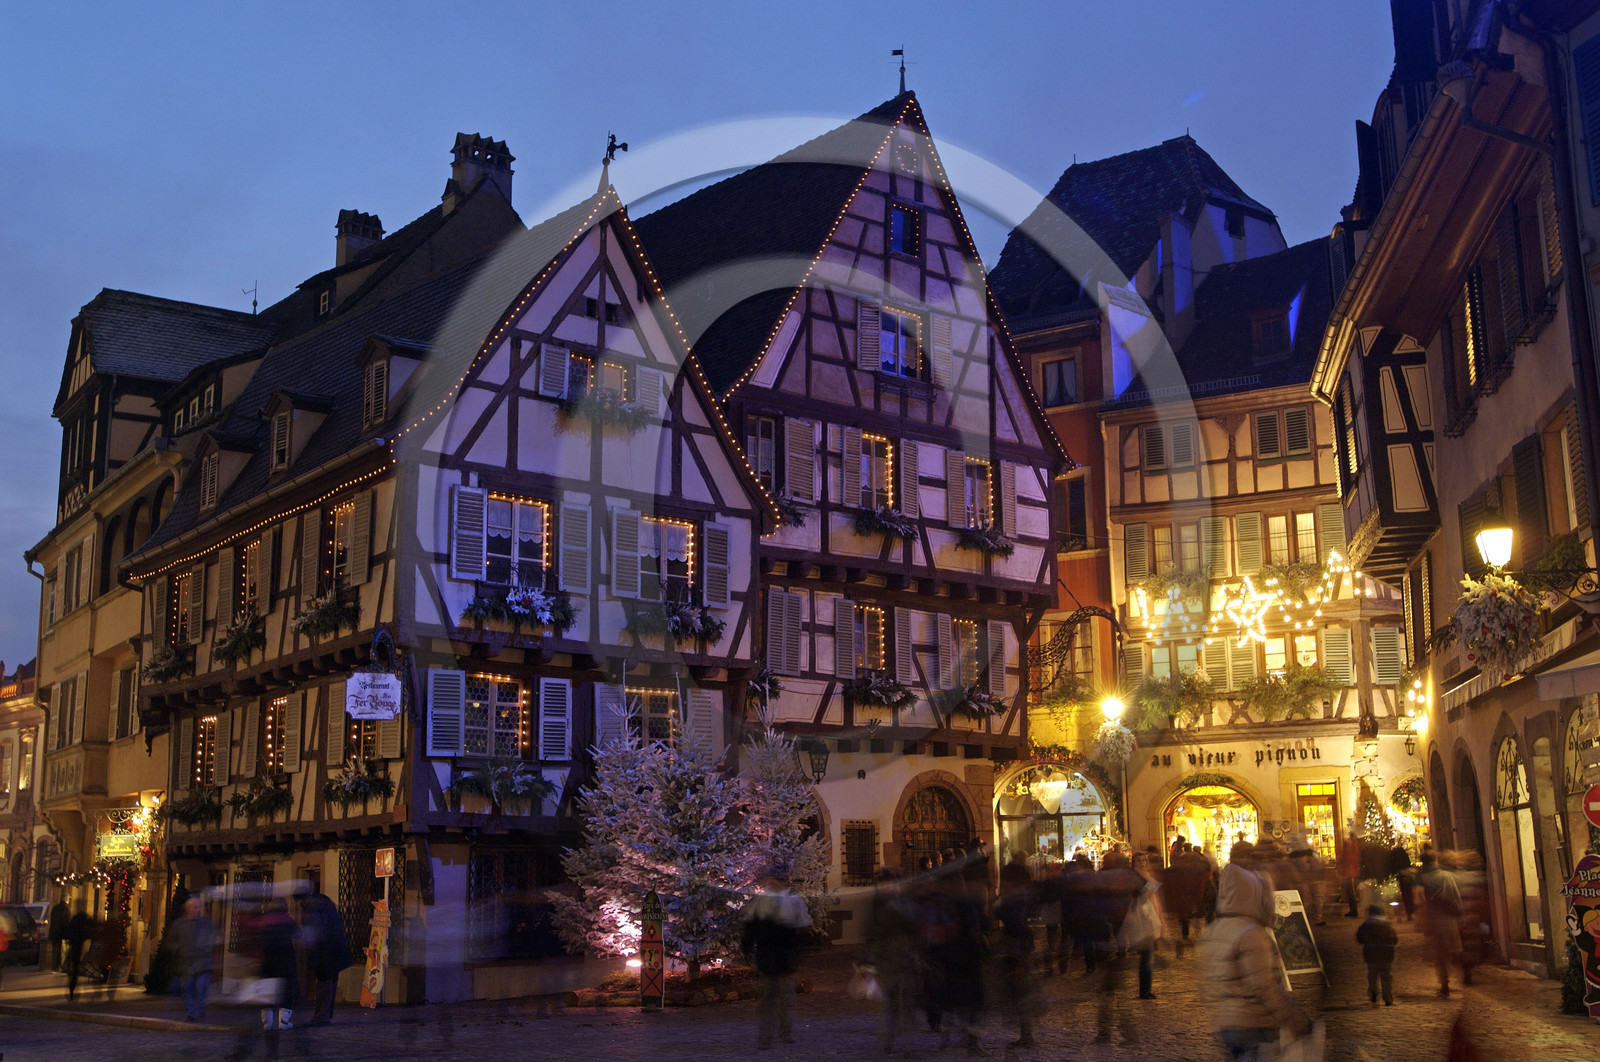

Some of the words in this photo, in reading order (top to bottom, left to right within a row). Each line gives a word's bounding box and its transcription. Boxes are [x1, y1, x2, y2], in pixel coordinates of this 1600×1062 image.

[1151, 753, 1171, 767] au
[1255, 744, 1321, 768] pignon
[1562, 883, 1600, 898] Jeanne
